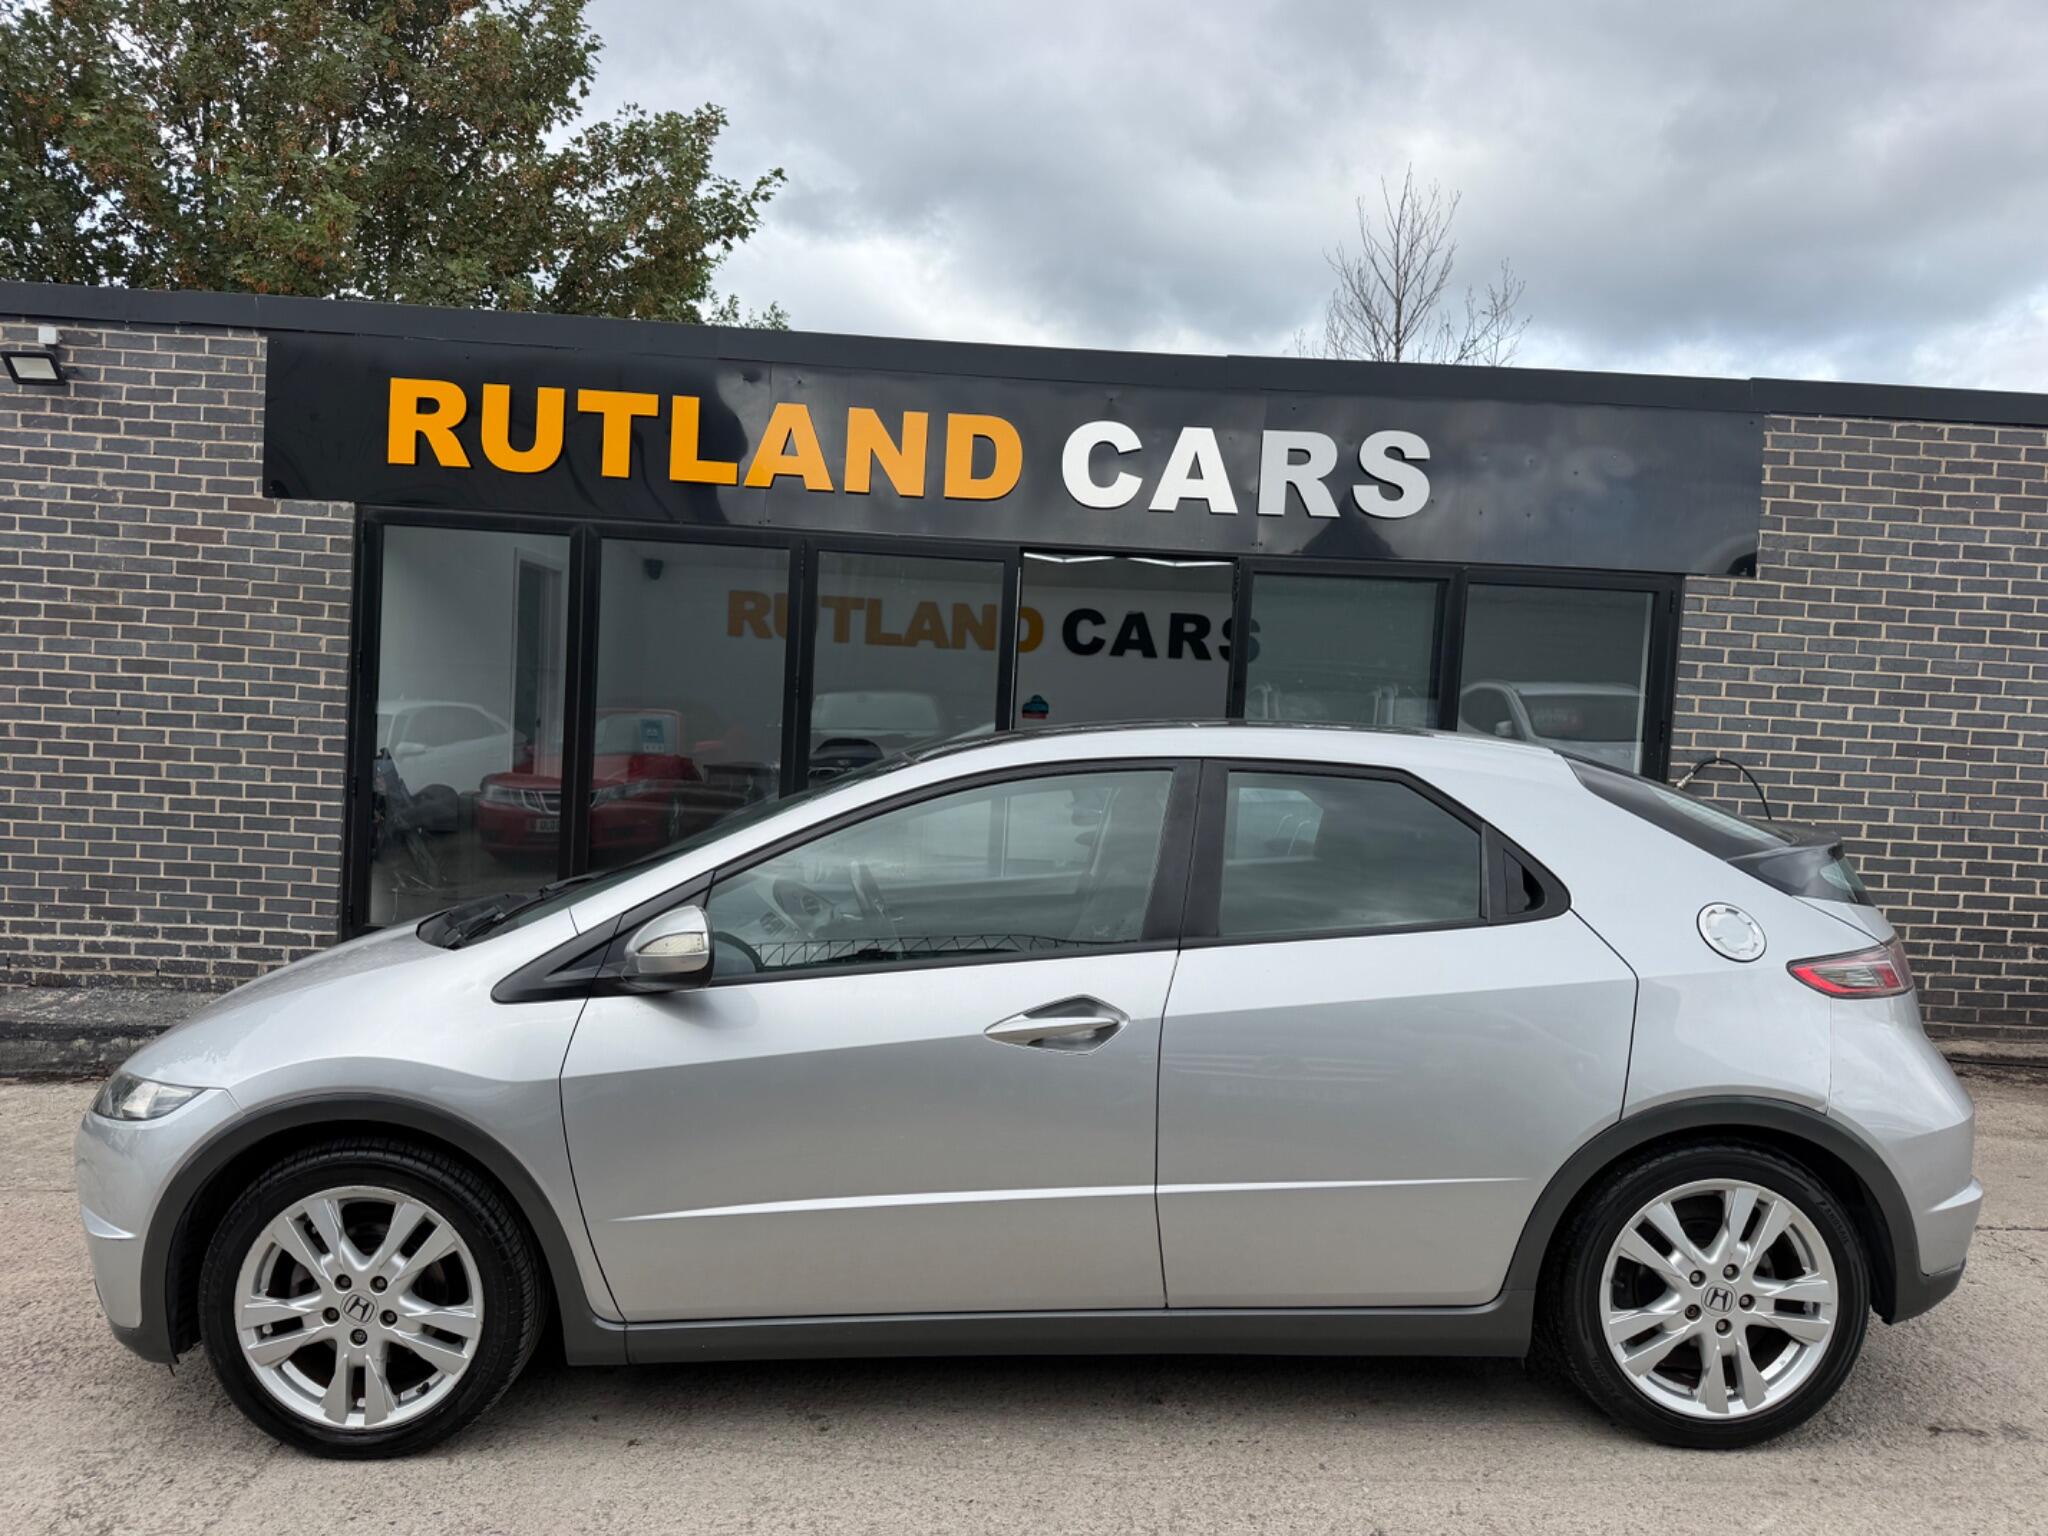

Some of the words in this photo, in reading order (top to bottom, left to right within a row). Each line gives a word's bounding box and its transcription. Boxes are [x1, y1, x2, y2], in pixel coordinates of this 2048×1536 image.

[386, 377, 1024, 501] RUTLAND
[1061, 421, 1432, 519] CARS
[1062, 608, 1261, 663] CARS
